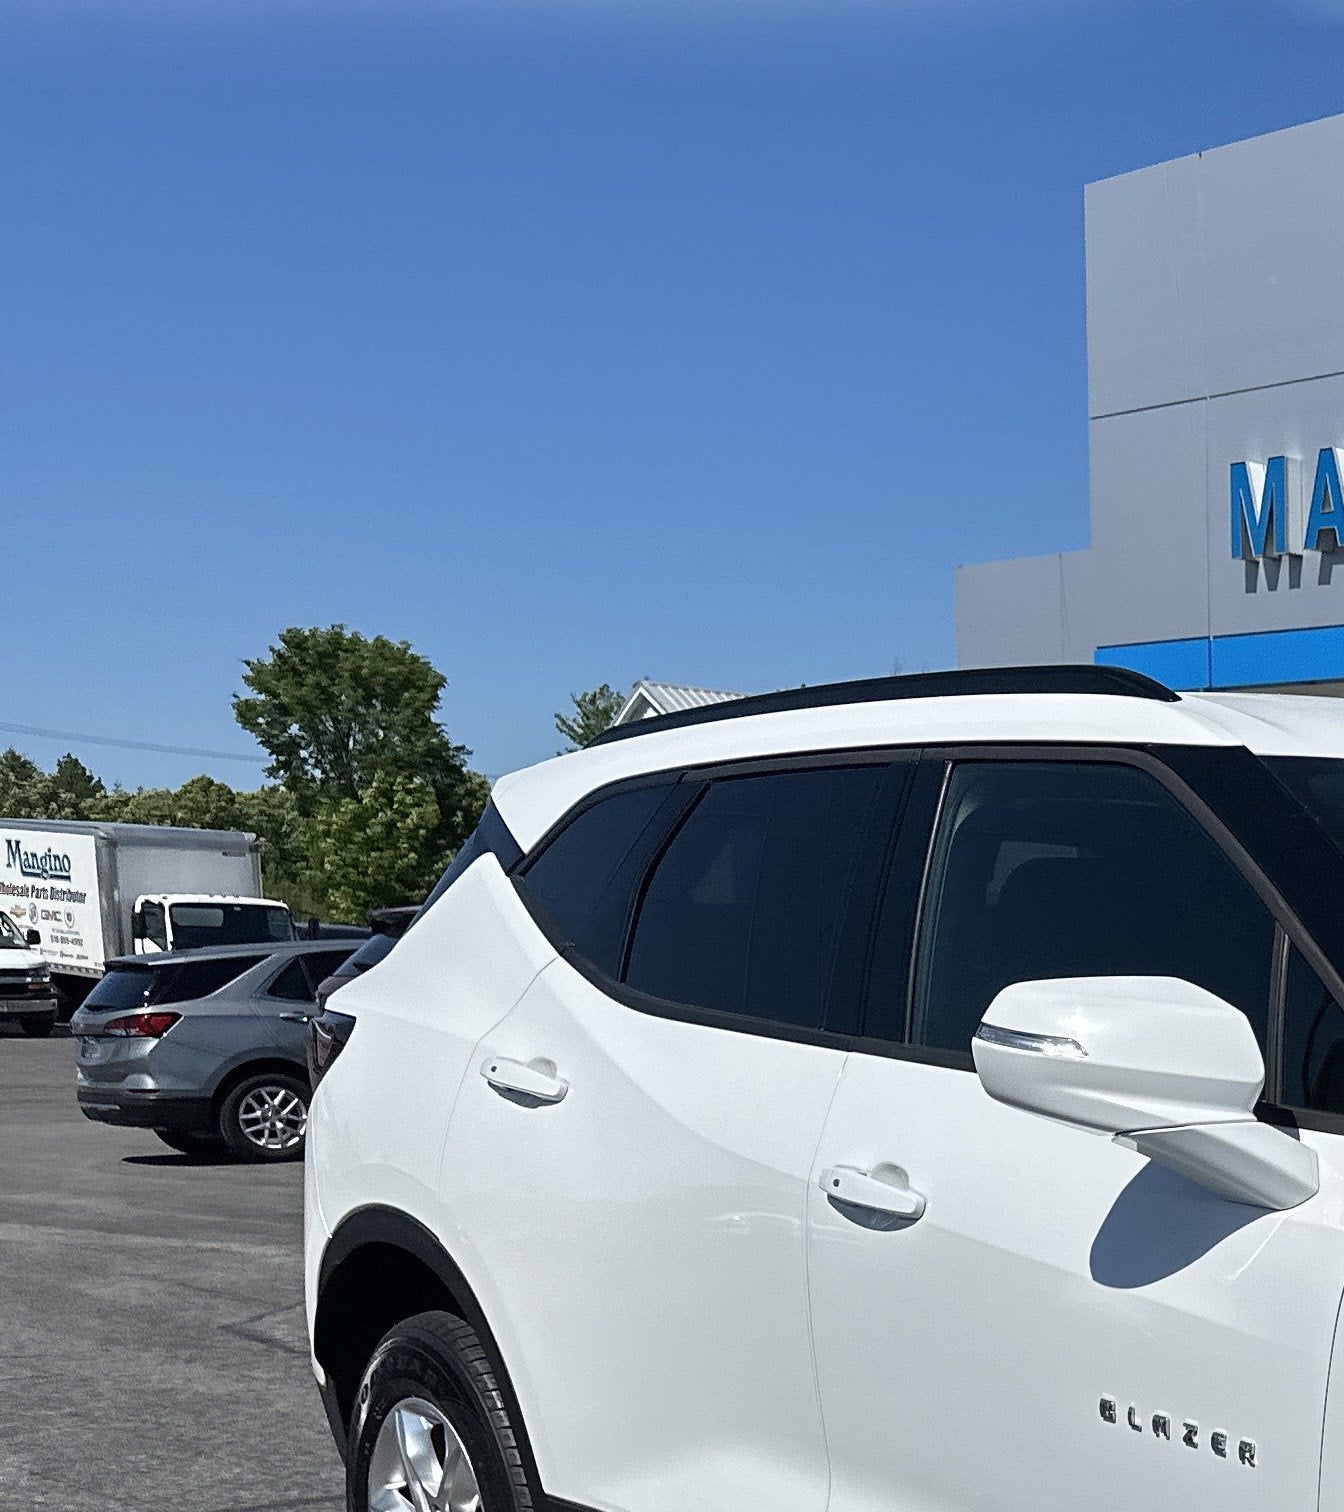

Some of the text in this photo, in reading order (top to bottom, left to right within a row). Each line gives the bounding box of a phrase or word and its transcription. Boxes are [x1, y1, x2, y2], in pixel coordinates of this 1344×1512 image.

[5, 839, 72, 880] Mangino
[31, 884, 48, 899] Parts
[1099, 1394, 1256, 1468] BLAZER
